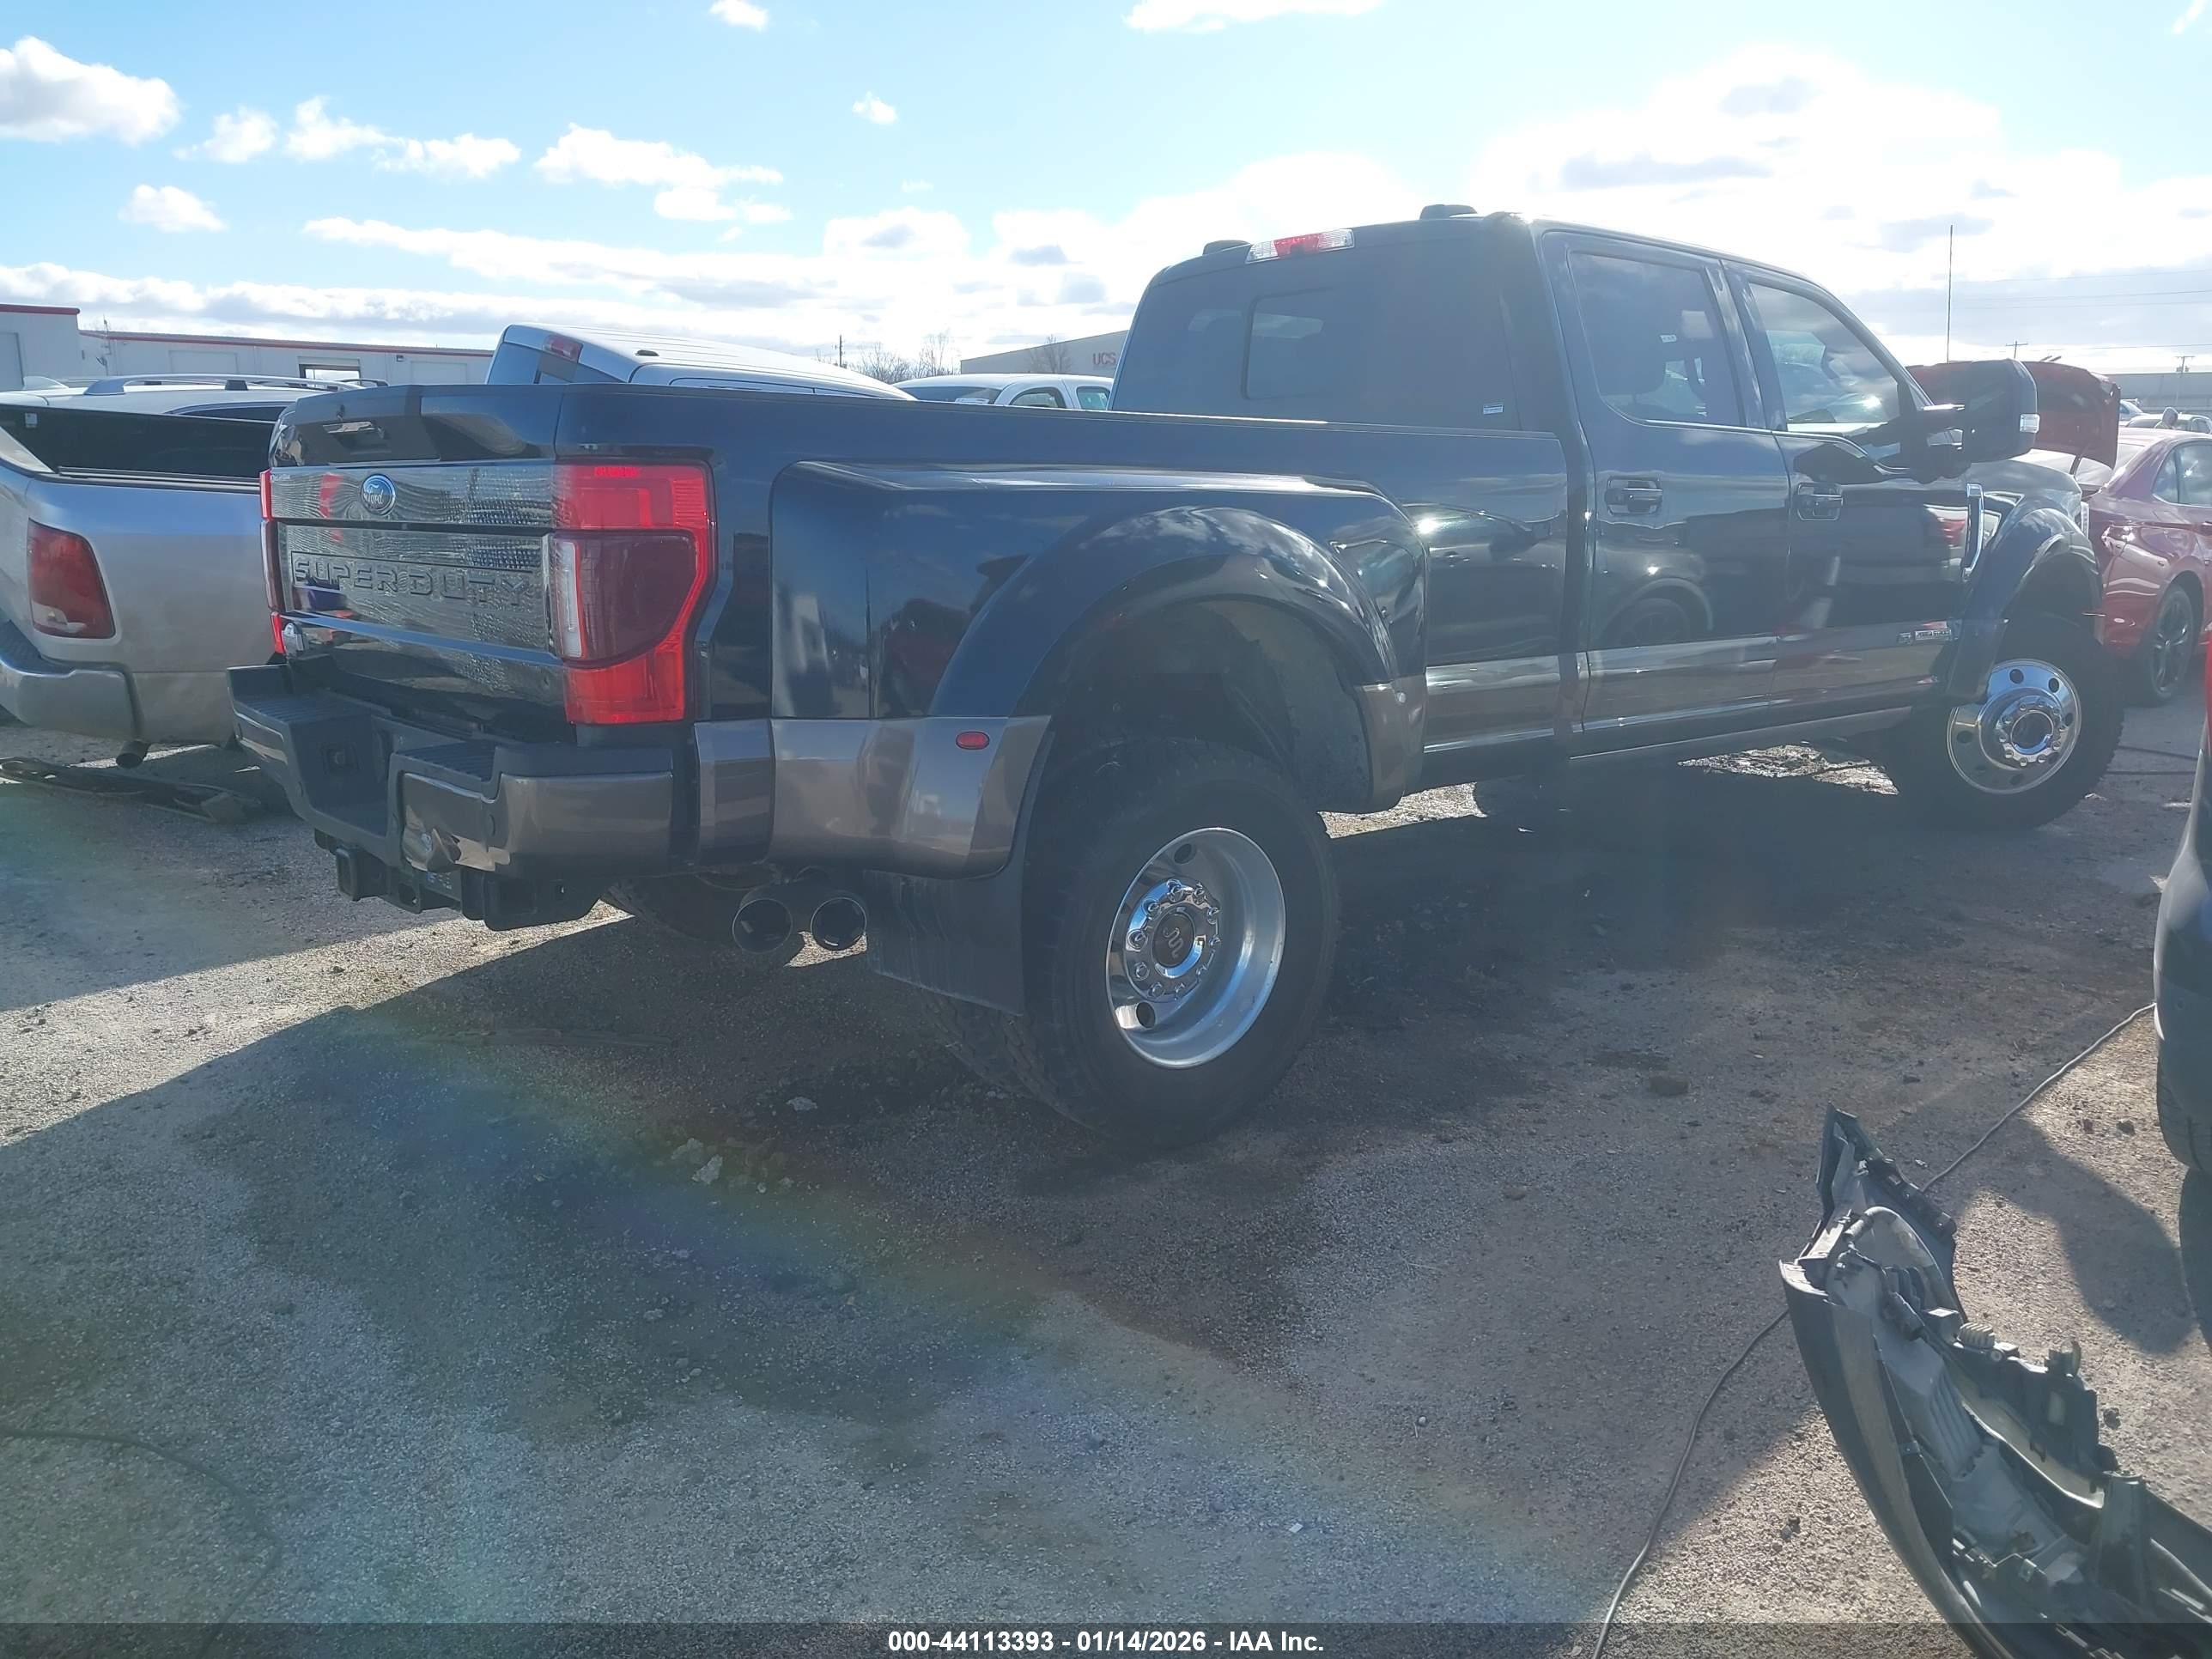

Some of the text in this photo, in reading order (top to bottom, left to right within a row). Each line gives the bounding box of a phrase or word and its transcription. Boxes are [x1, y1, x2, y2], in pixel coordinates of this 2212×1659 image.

[364, 483, 384, 505] Ford
[293, 557, 528, 606] SUPER DUTY
